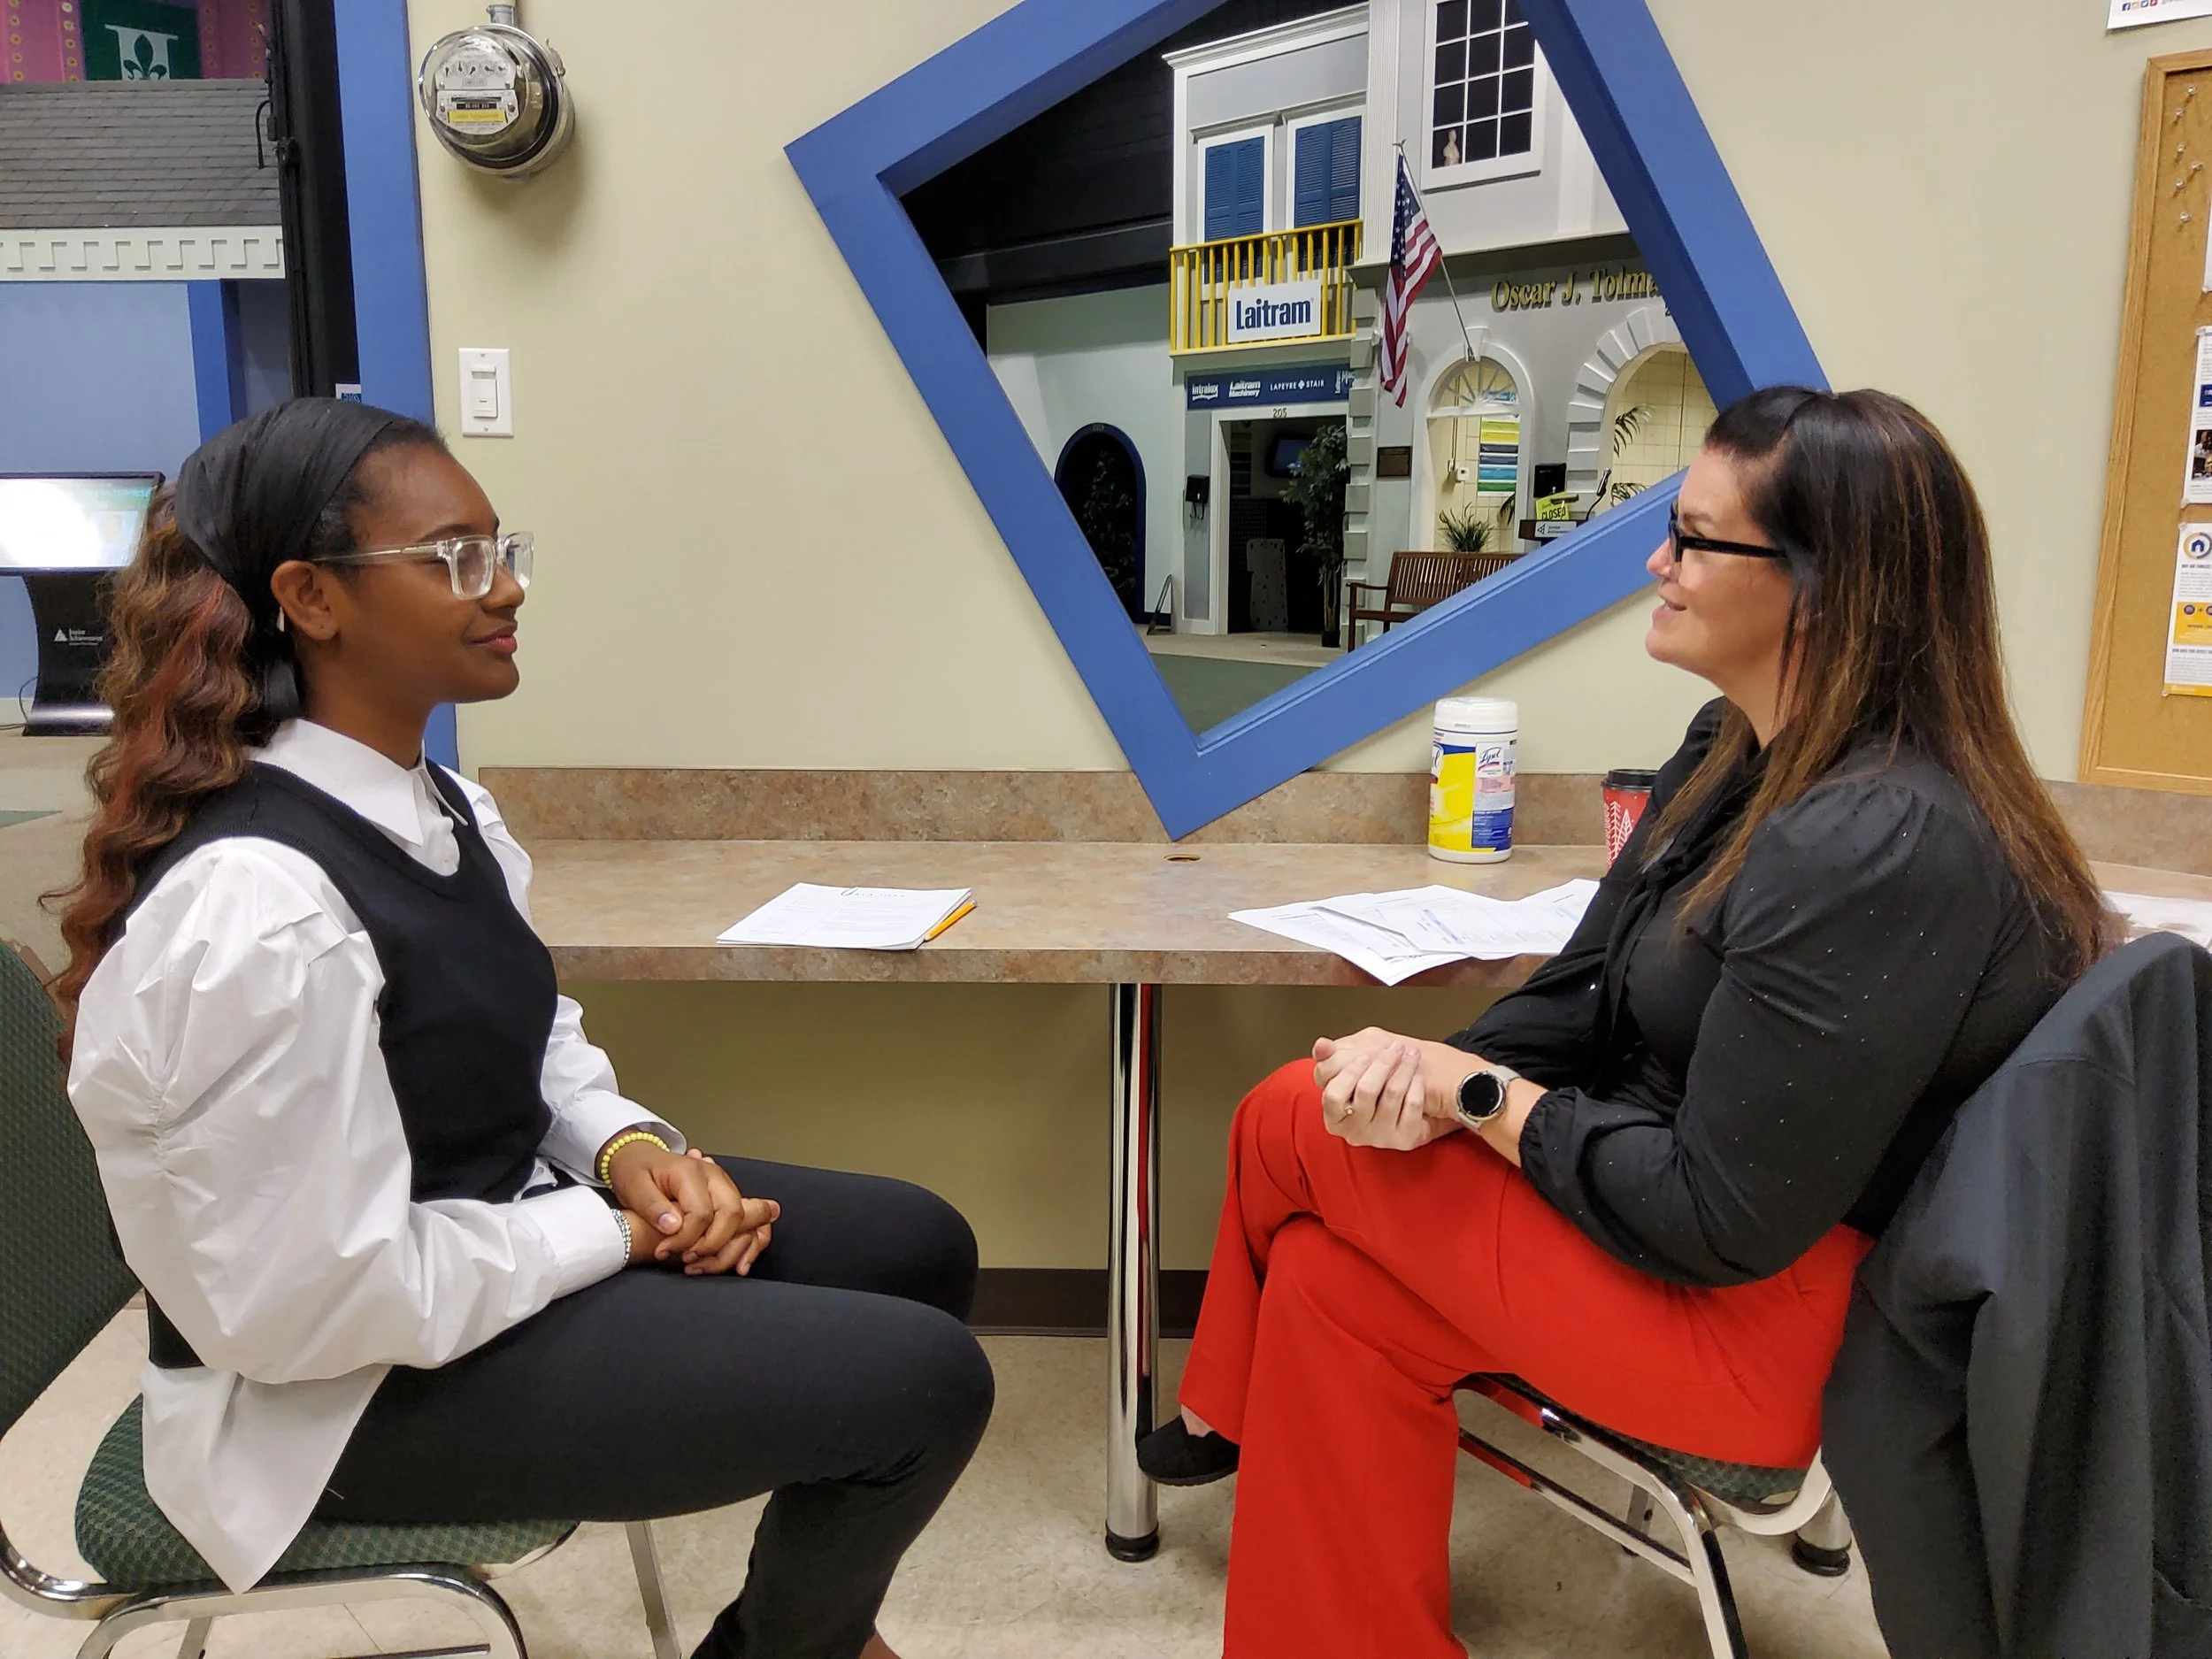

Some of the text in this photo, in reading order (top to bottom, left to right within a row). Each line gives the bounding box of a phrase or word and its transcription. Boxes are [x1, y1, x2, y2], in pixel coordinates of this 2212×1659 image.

[1491, 280, 1557, 311] Oscar
[1561, 270, 1582, 306] J.
[1236, 298, 1311, 330] Laitram
[1229, 380, 1261, 390] Laitram
[1270, 381, 1297, 391] LAPEYRE
[1306, 379, 1325, 388] STAIR
[1272, 408, 1287, 419] 205
